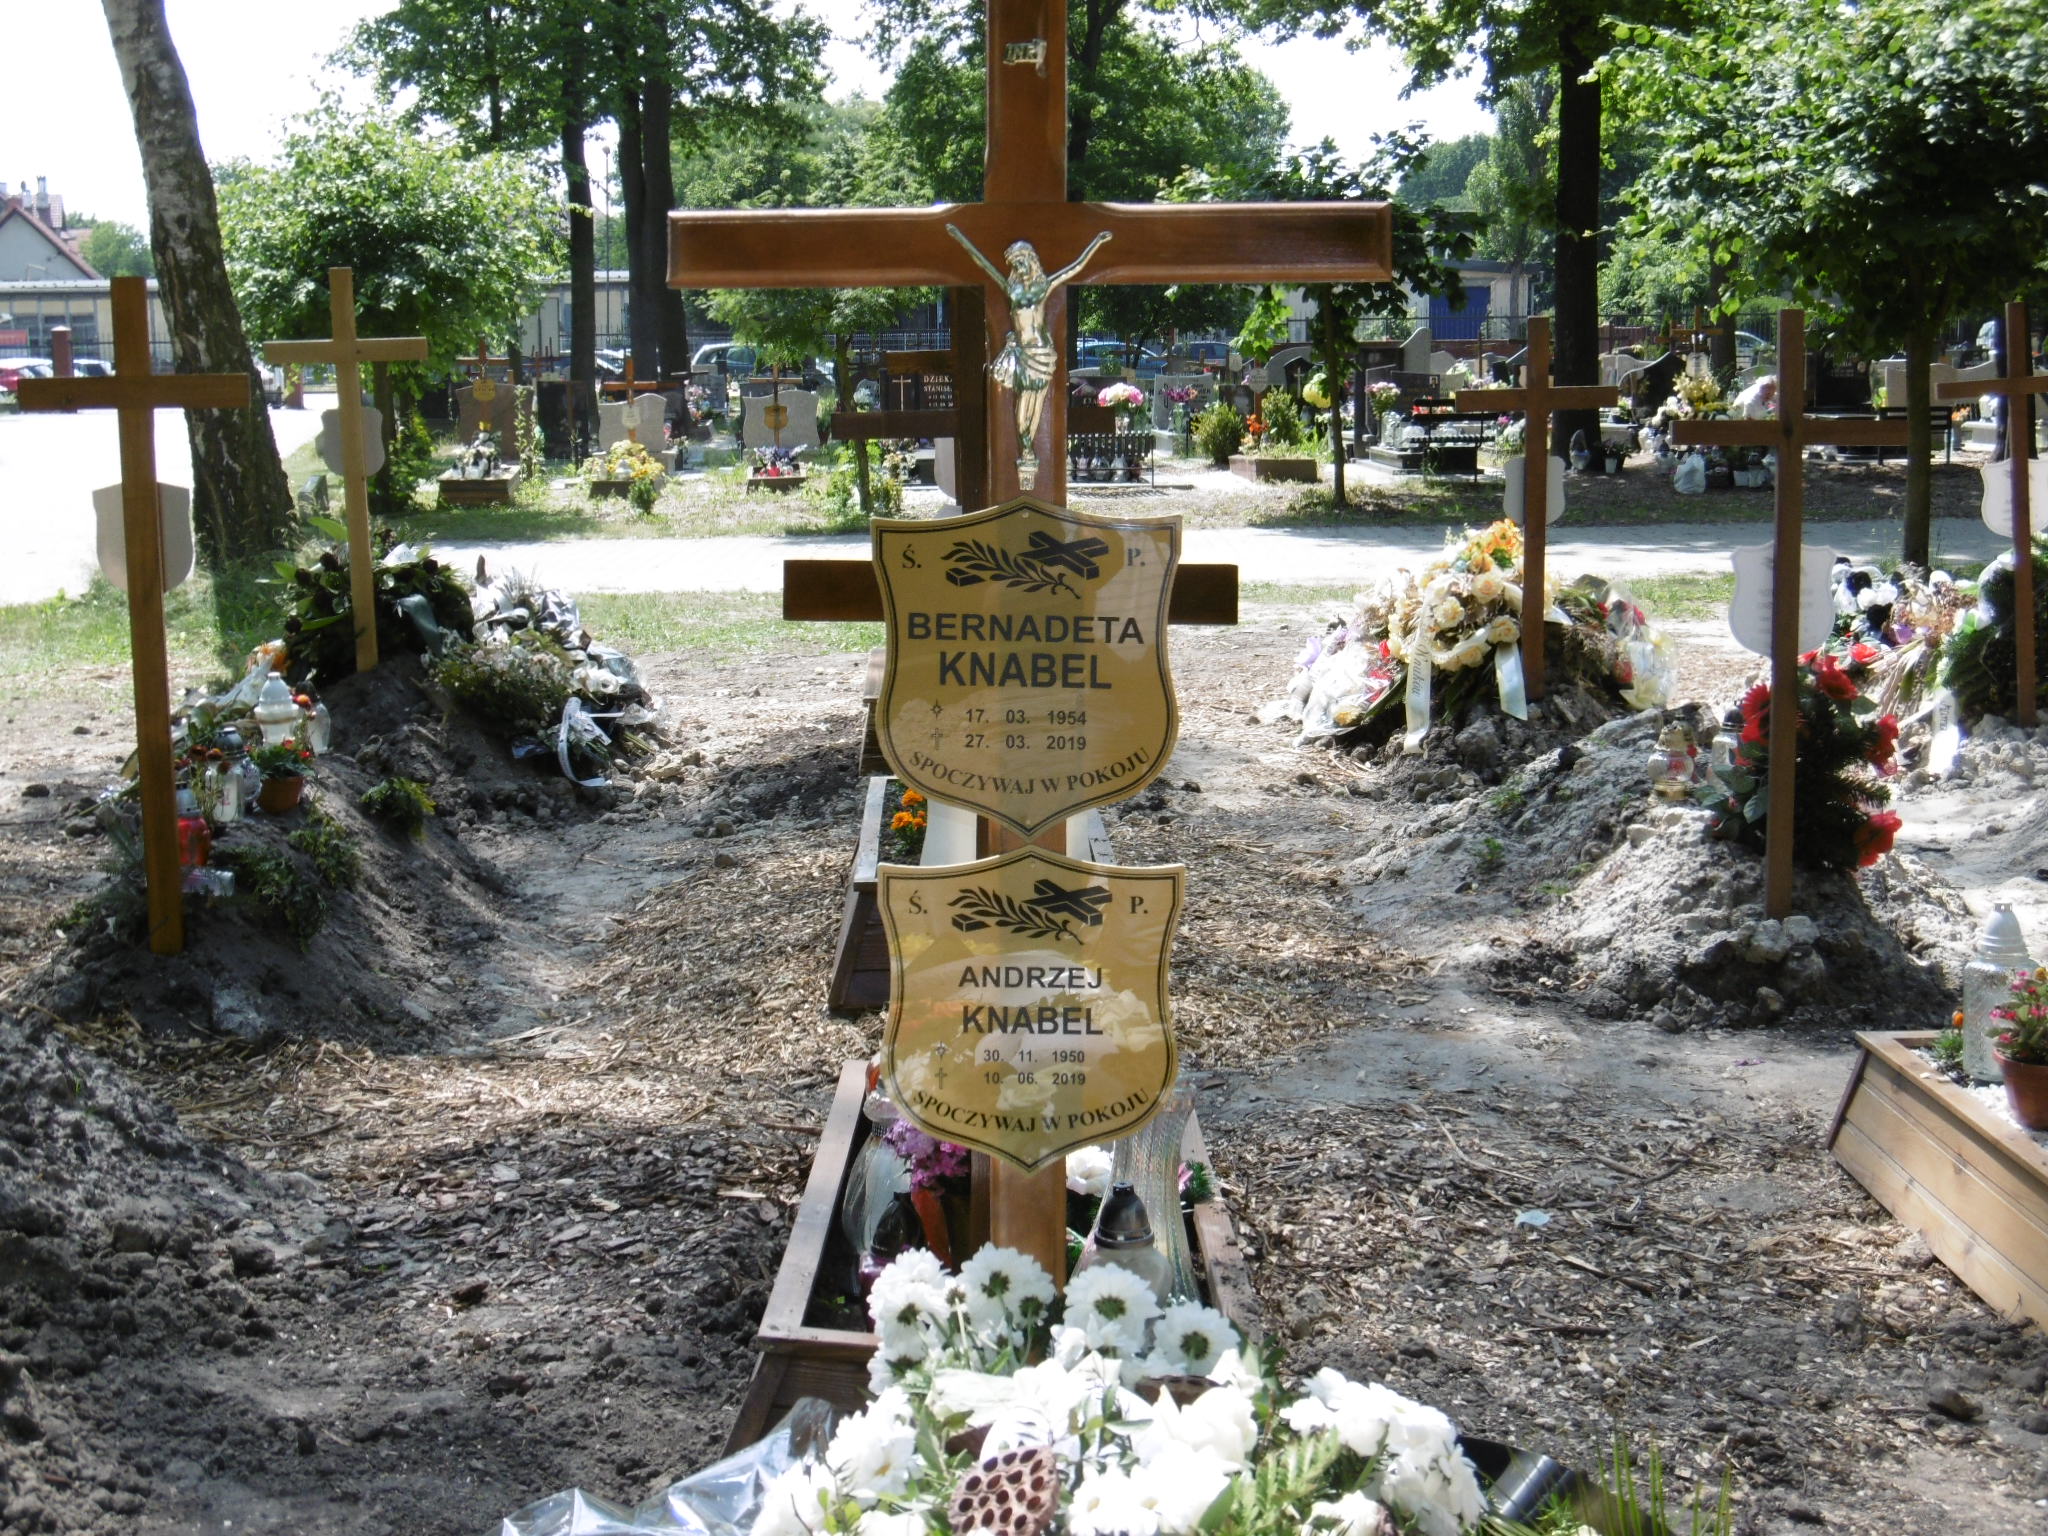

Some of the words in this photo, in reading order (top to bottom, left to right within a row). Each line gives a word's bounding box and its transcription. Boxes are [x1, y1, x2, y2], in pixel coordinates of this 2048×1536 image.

[923, 375, 953, 383] DZIEK
[901, 543, 922, 570] Ś.
[1127, 547, 1146, 567] P.
[907, 612, 1145, 645] BERNADETA
[938, 651, 1112, 690] KNABEL
[965, 709, 989, 725] 17.
[1005, 709, 1031, 725] 03.
[1047, 710, 1087, 726] 1954
[964, 734, 989, 750] 27.
[1005, 735, 1031, 750] 03.
[1046, 735, 1087, 751] 2019
[908, 750, 1035, 795] SPOCZYWAJ
[1041, 779, 1061, 793] W
[1067, 747, 1151, 791] POKOJU
[908, 890, 928, 914] Ś.
[1129, 895, 1149, 915] P.
[958, 965, 1103, 990] ANDRZEJ
[962, 1005, 1104, 1035] KNABEL
[983, 1049, 1004, 1063] 30.
[1018, 1049, 1037, 1063] 11.
[1051, 1050, 1085, 1063] 1950
[984, 1072, 1004, 1085] 10.
[1017, 1072, 1037, 1085] 06.
[1052, 1072, 1086, 1086] 2019
[912, 1090, 1036, 1132] SPOCZYWAJ
[1042, 1118, 1062, 1133] W
[1068, 1087, 1150, 1130] POKOJU
